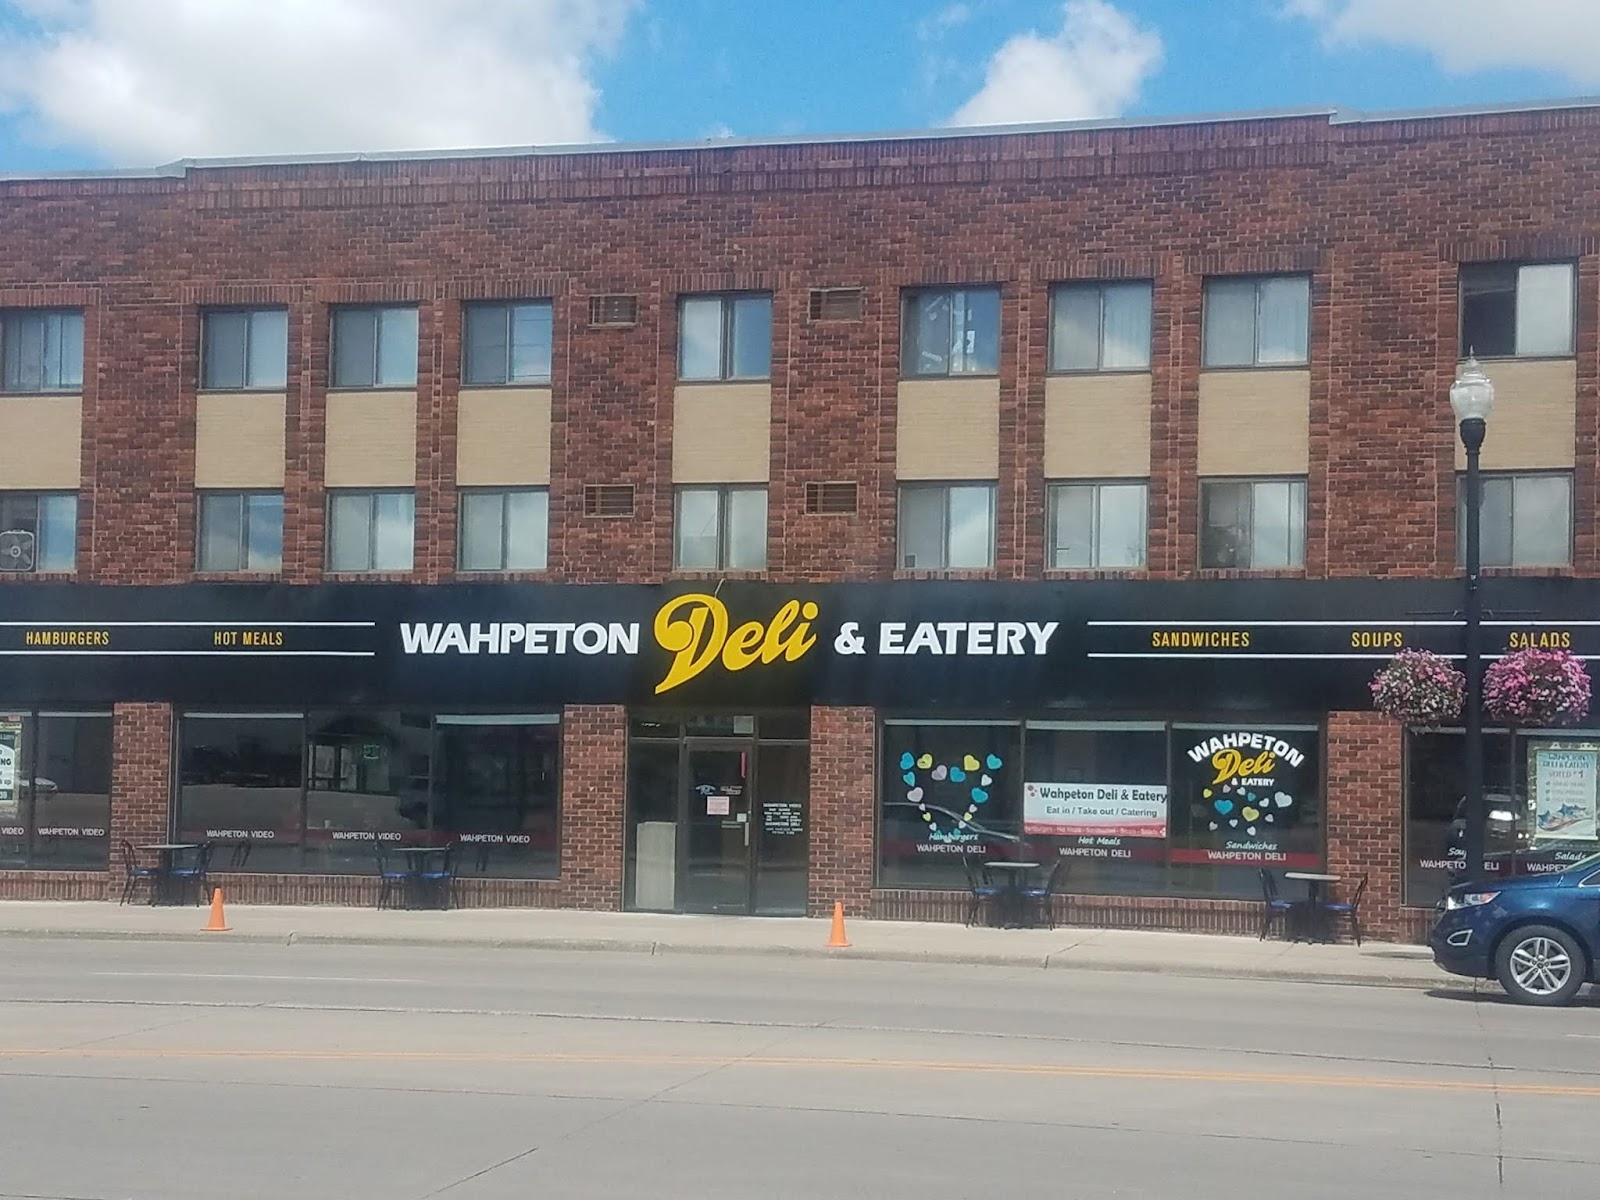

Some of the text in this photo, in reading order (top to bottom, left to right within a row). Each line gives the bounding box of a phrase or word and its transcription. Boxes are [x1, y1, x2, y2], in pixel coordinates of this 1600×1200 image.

[26, 631, 109, 646] HAMBURGERS
[214, 631, 283, 646] HOT MEALS
[401, 593, 1060, 695] WAHPETON Deli & EATERY
[1152, 631, 1250, 648] SANDWICHES
[1351, 631, 1403, 648] SOUPS
[1509, 631, 1571, 649] SALADS
[1187, 732, 1305, 768] WAHPETON
[1212, 748, 1276, 785] Deli
[1231, 778, 1275, 786] & EATERY
[1040, 787, 1168, 803] Wahpeton Deli & Eatery
[1046, 805, 1060, 814] Eat
[1062, 805, 1071, 814] in
[1078, 806, 1098, 815] Take
[1099, 808, 1114, 816] out
[1121, 807, 1158, 818] Catering
[1, 827, 25, 836] VIDEO
[38, 827, 105, 837] WAHPETON VIDEO
[206, 829, 275, 839] WAHPETON VIDEO
[332, 831, 402, 841] WAHPETON VIDEO
[460, 833, 530, 843] WAHPETON VIDEO
[916, 844, 987, 854] WAHPETON DELI
[1225, 841, 1278, 851] Sandwiches
[1059, 847, 1132, 858] WAHPETON DELI
[1207, 850, 1287, 861] WAHPETON DELI
[1419, 859, 1500, 871] WAHPETO ELI
